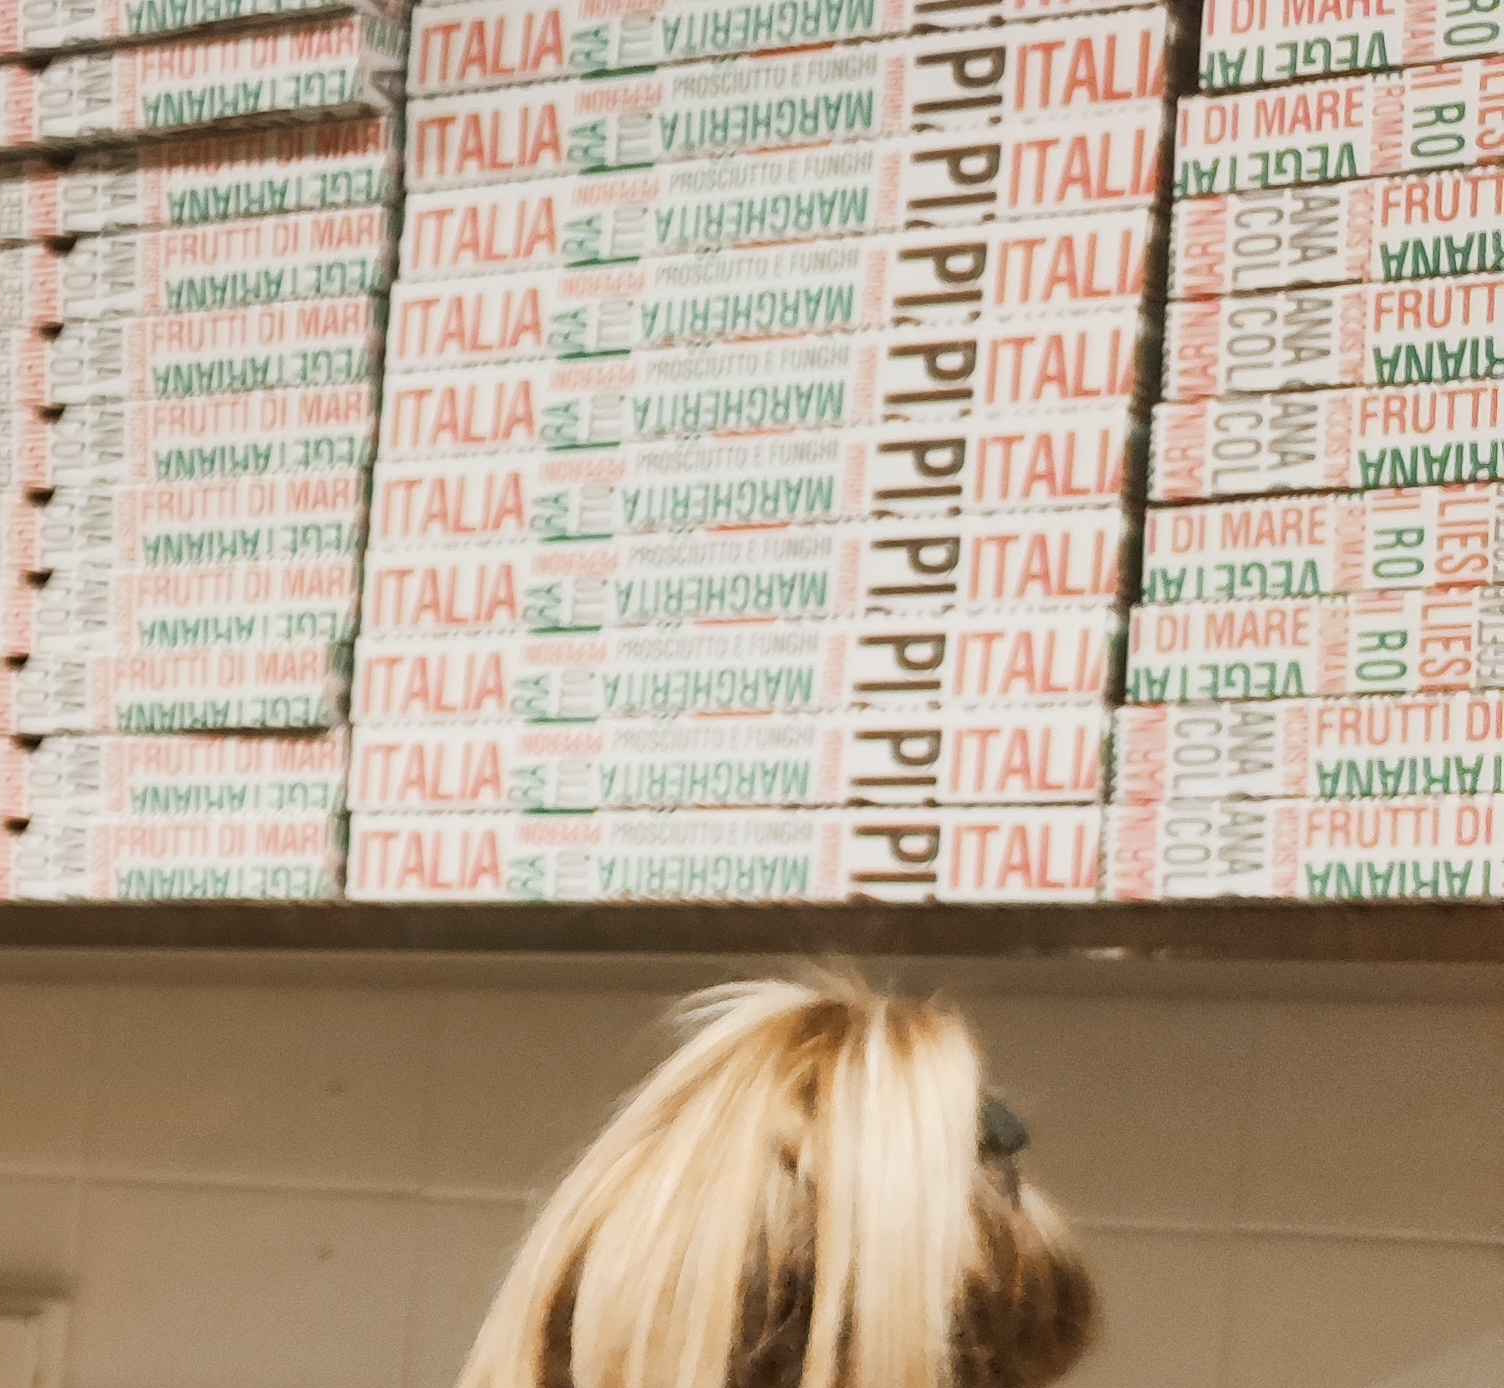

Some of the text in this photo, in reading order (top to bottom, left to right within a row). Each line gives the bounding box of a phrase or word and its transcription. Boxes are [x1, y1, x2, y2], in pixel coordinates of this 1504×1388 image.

[418, 9, 565, 84] ITALIA
[661, 0, 874, 54] MARGHERITA
[659, 88, 873, 151] MARGHERITA
[1255, 86, 1365, 138] MARE
[414, 103, 562, 179] ITALIA
[311, 213, 374, 250] MAR
[410, 197, 557, 270] ITALIA
[655, 186, 869, 245] MARGHERITA
[297, 303, 360, 339] MAR
[397, 288, 542, 358] ITALIA
[641, 284, 854, 339] MARGHERITA
[299, 391, 363, 425] MAR
[389, 379, 534, 451] ITALIA
[633, 378, 846, 433] MARGHERITA
[1360, 388, 1498, 436] FRUTTI
[288, 479, 350, 512] MAR
[380, 472, 524, 539] ITALIA
[622, 474, 835, 524] MARGHERITA
[1221, 504, 1325, 550] MARE
[370, 564, 517, 626] ITALIA
[615, 570, 829, 617] MARGHERITA
[1204, 606, 1311, 649] MARE
[364, 652, 505, 714] ITALIA
[602, 665, 815, 708] MARGHERITA
[1316, 703, 1450, 745] FRUTTI
[360, 741, 503, 802] ITALIA
[598, 760, 810, 800] MARGHERITA
[1305, 806, 1440, 848] FRUTTI
[357, 829, 501, 890] ITALIA
[597, 854, 810, 893] MARGHERITA
